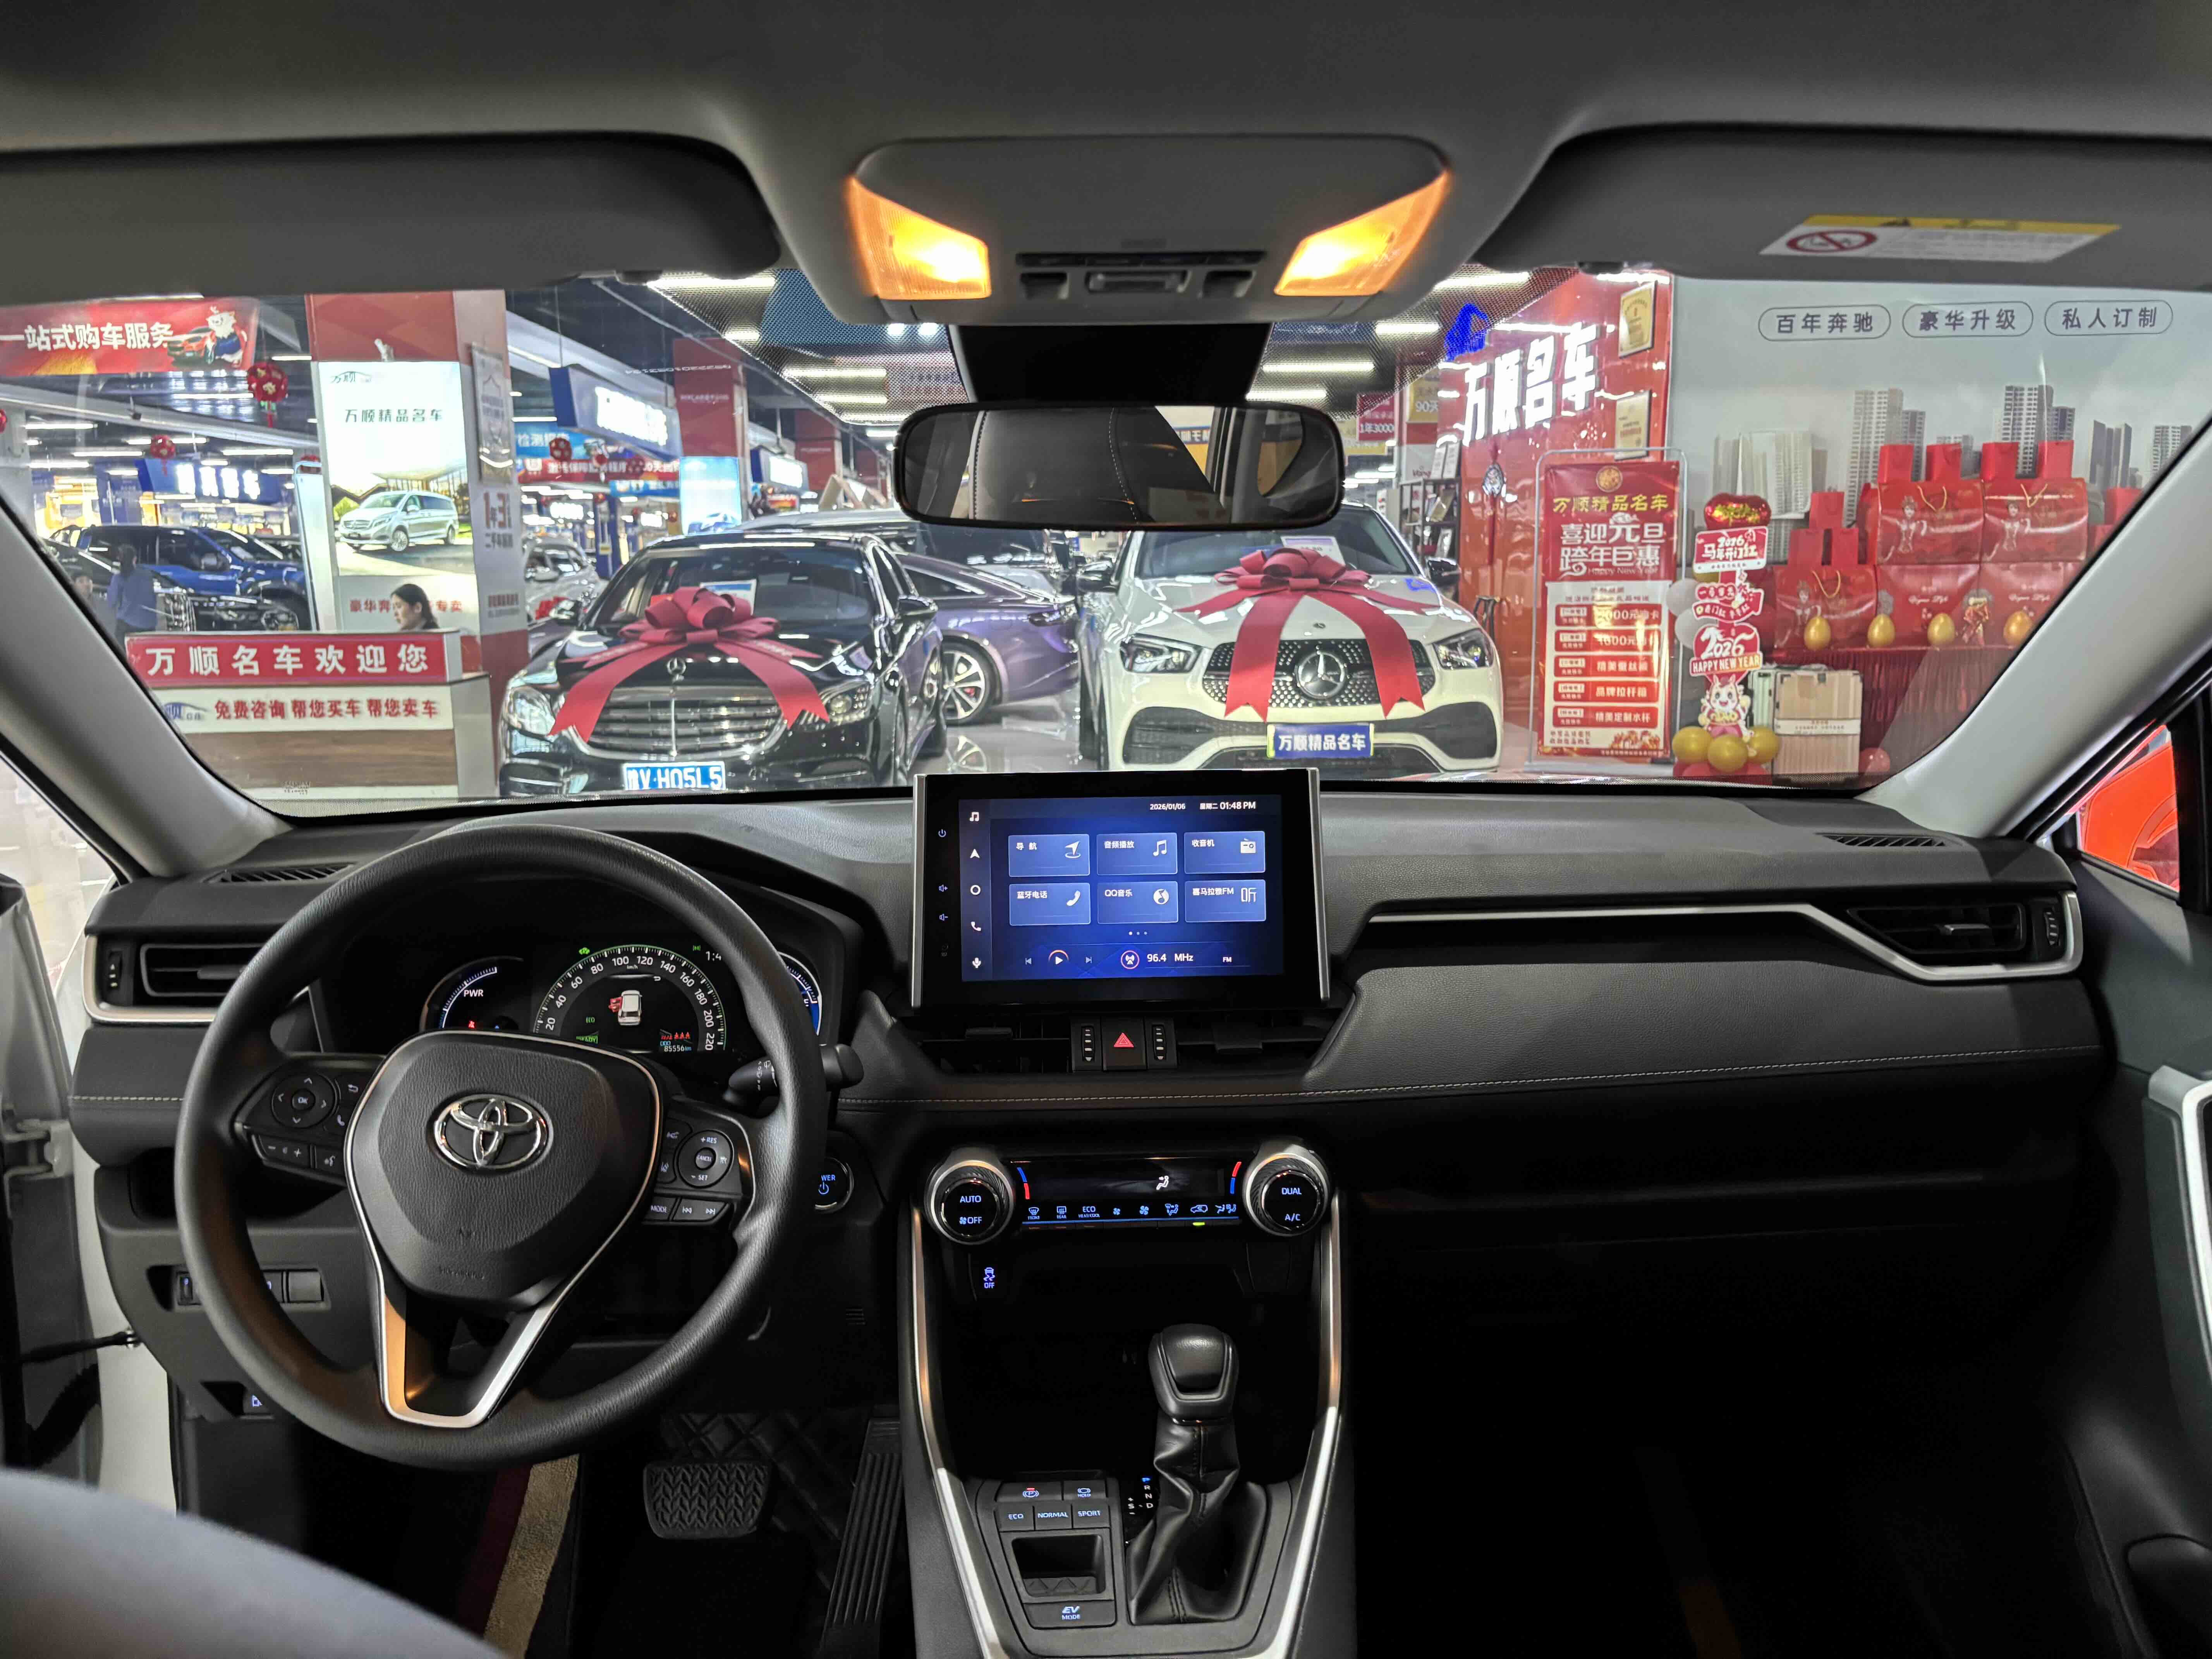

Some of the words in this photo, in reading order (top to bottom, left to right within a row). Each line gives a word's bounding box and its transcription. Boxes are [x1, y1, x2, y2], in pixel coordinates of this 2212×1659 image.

[1776, 312, 1874, 334] 百年奔驰
[1919, 309, 2016, 332] 豪华升级
[2062, 307, 2157, 330] 私人订制
[0, 322, 173, 352] 一站式购车服务
[1462, 322, 1598, 447] 万顺名车
[345, 409, 443, 423] 万顺精品名车
[1553, 495, 1668, 513] 万顺精品名车
[1560, 522, 1666, 545] 喜迎元旦
[1559, 545, 1660, 574] 跨年巨惠
[1700, 627, 1755, 660] 2026
[146, 644, 429, 676] 万顺名车欢迎您
[1693, 660, 1718, 673] HAPPY
[1719, 658, 1736, 670] NEW
[1737, 654, 1760, 668] YEAR
[215, 699, 286, 719] 免费咨询
[292, 699, 360, 718] 帮您买车
[367, 699, 438, 718] 帮您卖车
[1278, 733, 1366, 751] 万顺精品名车
[1104, 841, 1134, 849] 音频播放
[1192, 839, 1214, 847] 收音机
[1104, 889, 1133, 897] QQ音乐
[1192, 887, 1234, 896] 喜马拉雅FM
[612, 956, 629, 966] 100
[637, 955, 653, 965] 120
[706, 951, 721, 961] 1:4
[1147, 953, 1166, 963] 96.4
[1174, 953, 1194, 962] MHz
[591, 963, 604, 974] 80
[660, 960, 676, 973] 140
[570, 976, 583, 989] 60
[679, 972, 695, 988] 160
[464, 989, 484, 997] PWR
[555, 994, 567, 1008] 40
[694, 989, 708, 1006] 180
[546, 1017, 556, 1031] 20
[703, 1009, 714, 1028] 200
[705, 1032, 715, 1051] 220
[1285, 1213, 1301, 1221] A/C
